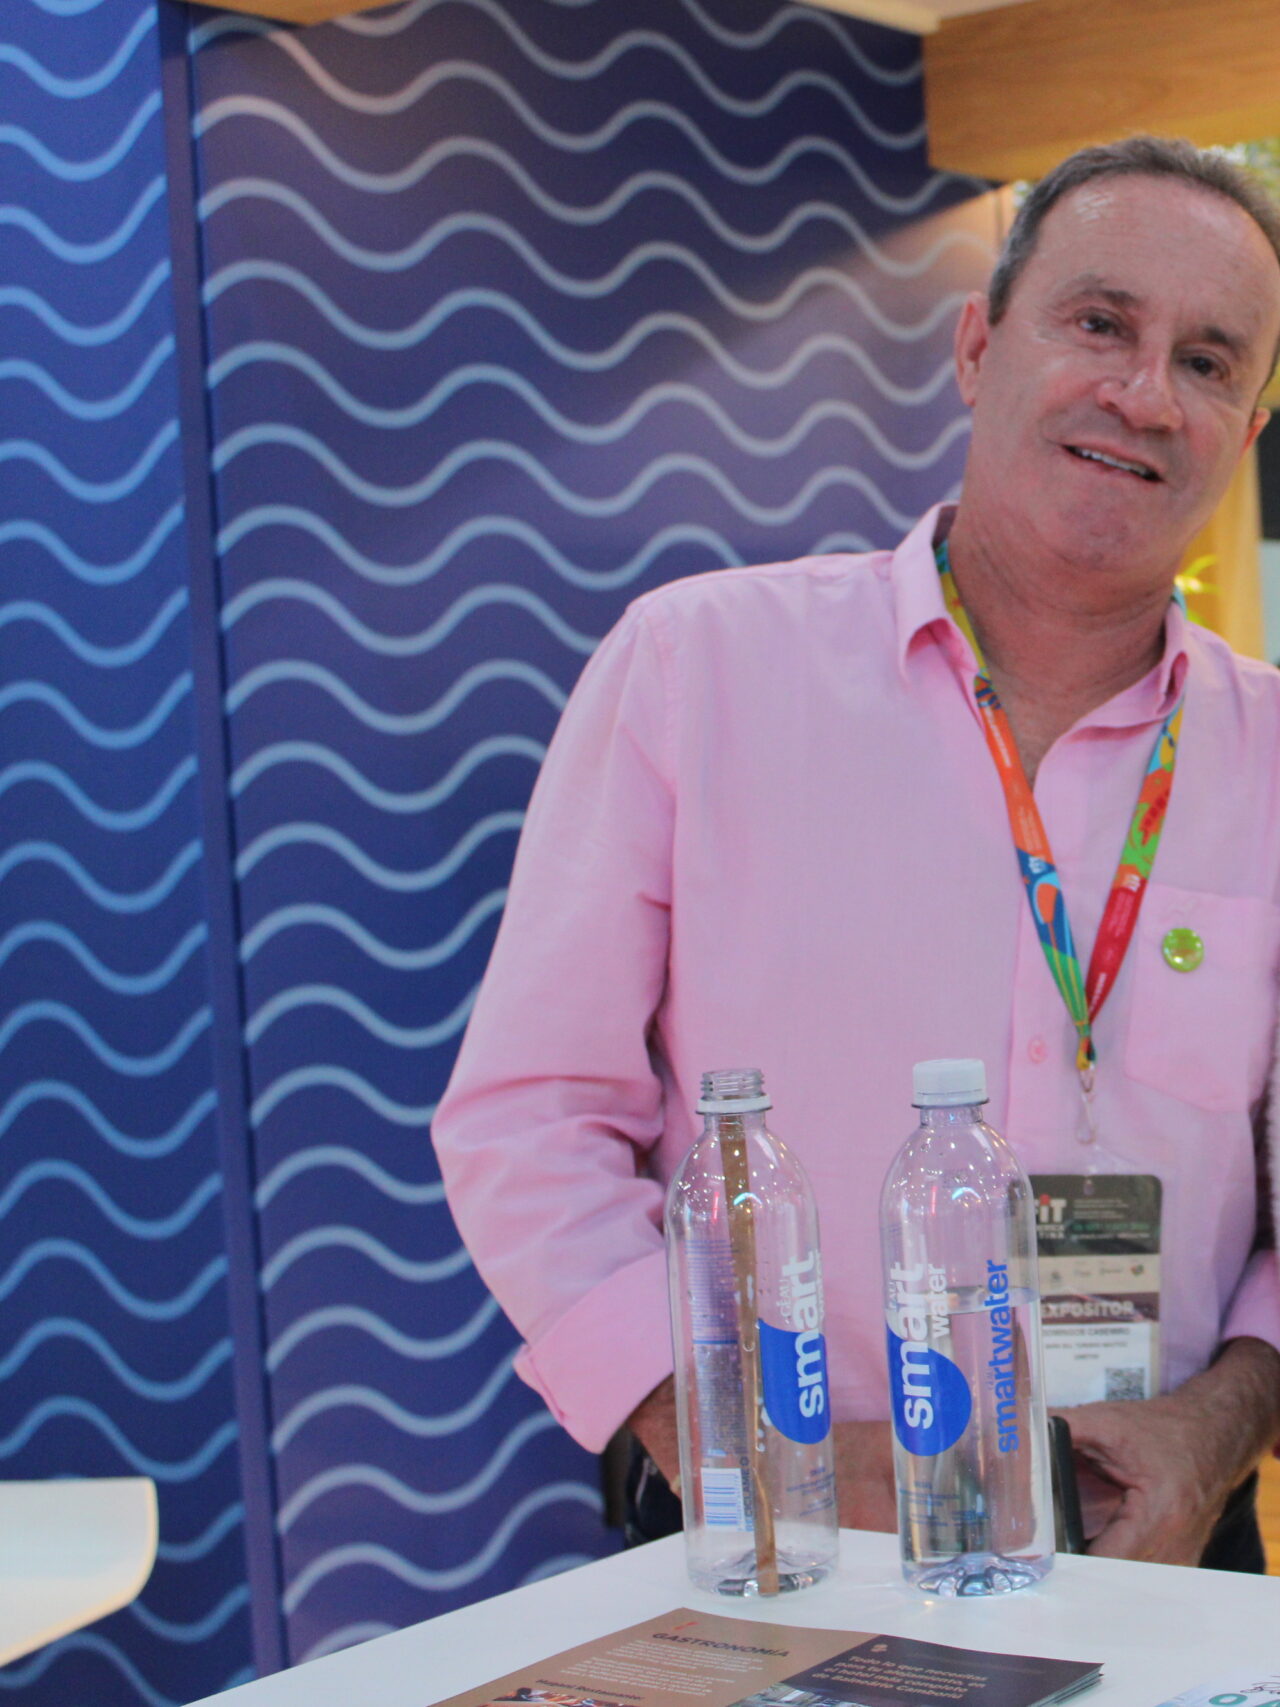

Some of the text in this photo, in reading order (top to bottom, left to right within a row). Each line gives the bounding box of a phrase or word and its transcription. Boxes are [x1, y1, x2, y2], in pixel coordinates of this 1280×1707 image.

[782, 1249, 825, 1418] smart
[890, 1262, 934, 1430] smart
[928, 1263, 950, 1339] water
[984, 1260, 1019, 1453] smartwater
[1041, 1301, 1134, 1318] EXPOSITOR
[652, 1632, 789, 1657] GASTRONOMÍA
